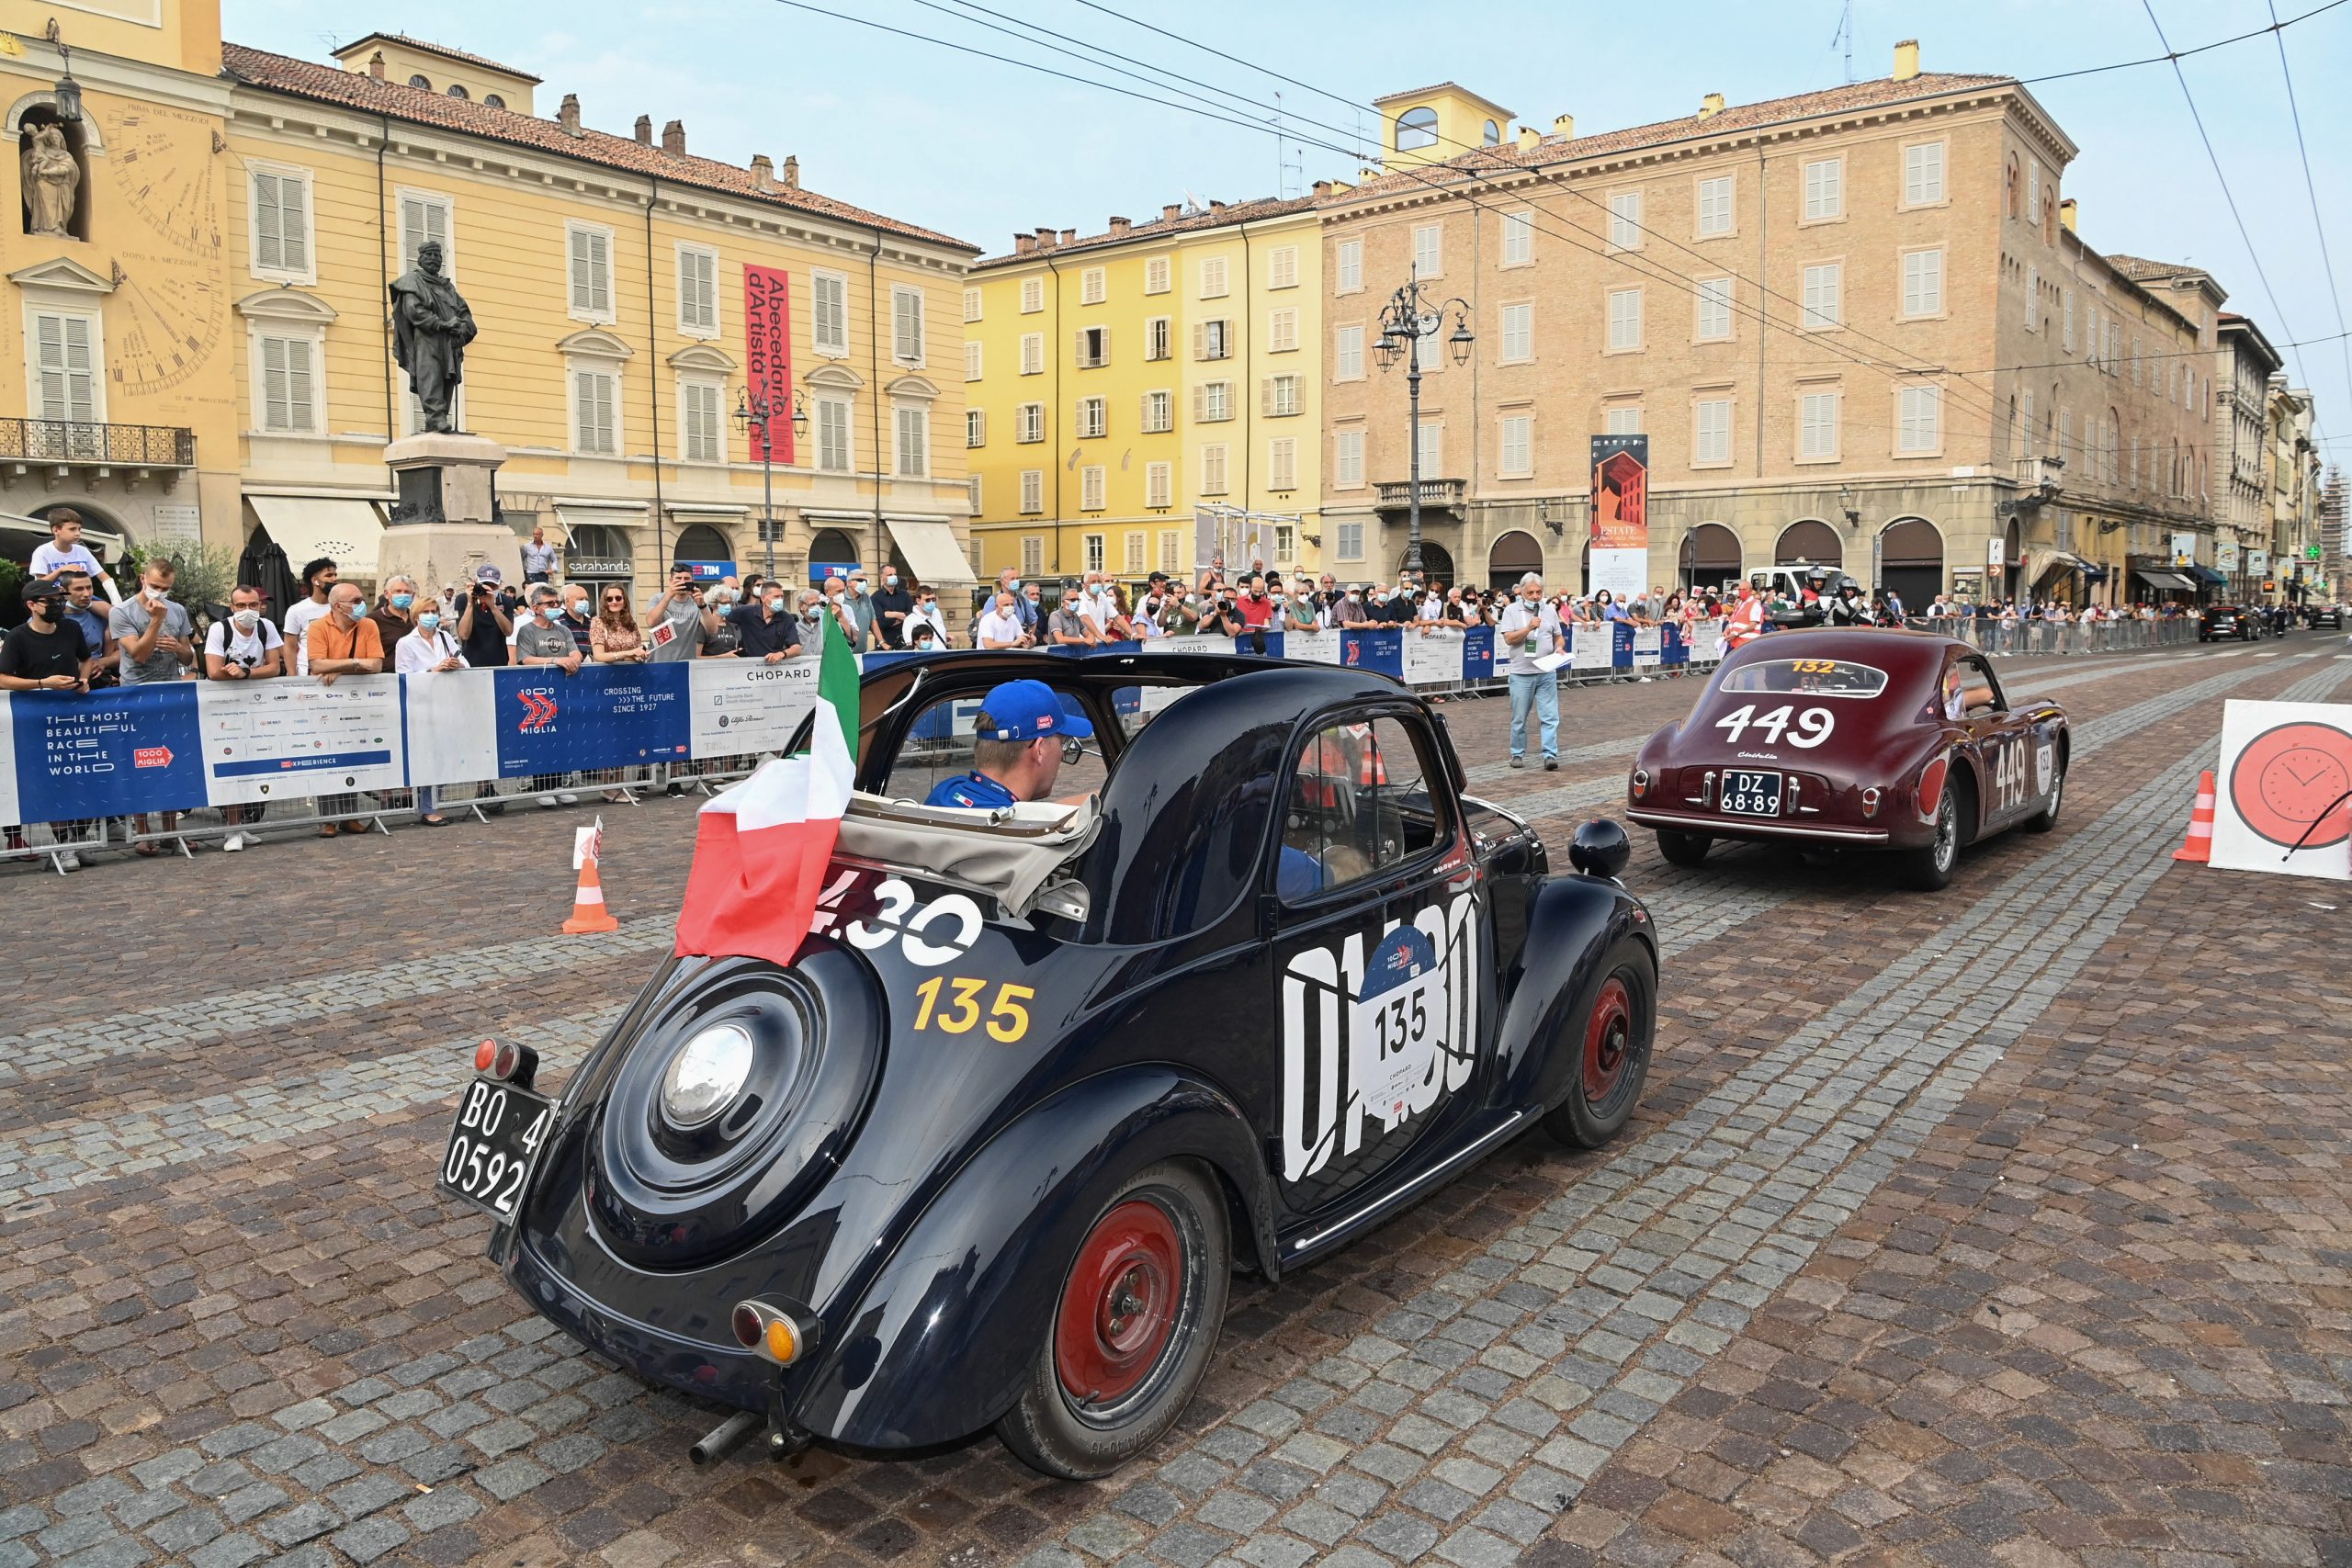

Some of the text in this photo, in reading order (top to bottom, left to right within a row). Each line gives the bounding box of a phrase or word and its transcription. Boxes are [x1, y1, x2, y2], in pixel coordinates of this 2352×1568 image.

[128, 104, 150, 114] PRIMA
[153, 108, 169, 118] DEL
[122, 251, 145, 261] DOPO
[749, 272, 766, 374] d'Artista
[768, 276, 786, 415] Abecedario
[1600, 526, 1637, 536] ESTATE
[568, 559, 630, 572] sarabanda
[702, 565, 720, 576] TIM
[832, 567, 848, 576] TIM
[1172, 645, 1208, 653] CHOPARD
[1792, 660, 1836, 674] 132
[746, 669, 811, 681] CHOPARD
[520, 687, 555, 696] 1000
[604, 686, 641, 696] CROSSING
[649, 693, 675, 702] FUTURE
[613, 703, 657, 714] SINCE 1927
[46, 711, 130, 725] THE MOST
[46, 723, 137, 738] BEAUTIFUL
[520, 726, 557, 735] MIGLIA
[1715, 705, 1836, 749] 449
[47, 739, 99, 750] RACE
[48, 750, 108, 763] IN THE
[138, 750, 163, 759] 1000
[137, 758, 165, 766] MIGLIA
[2040, 750, 2050, 773] 132
[49, 762, 115, 776] WORLD
[1996, 739, 2026, 810] 449
[1738, 774, 1764, 794] DZ
[913, 976, 1035, 1043] 135
[1374, 986, 1427, 1062] 135
[1389, 1064, 1412, 1080] CHOPARD
[461, 1081, 548, 1155] BO 4
[447, 1135, 526, 1213] 0592
